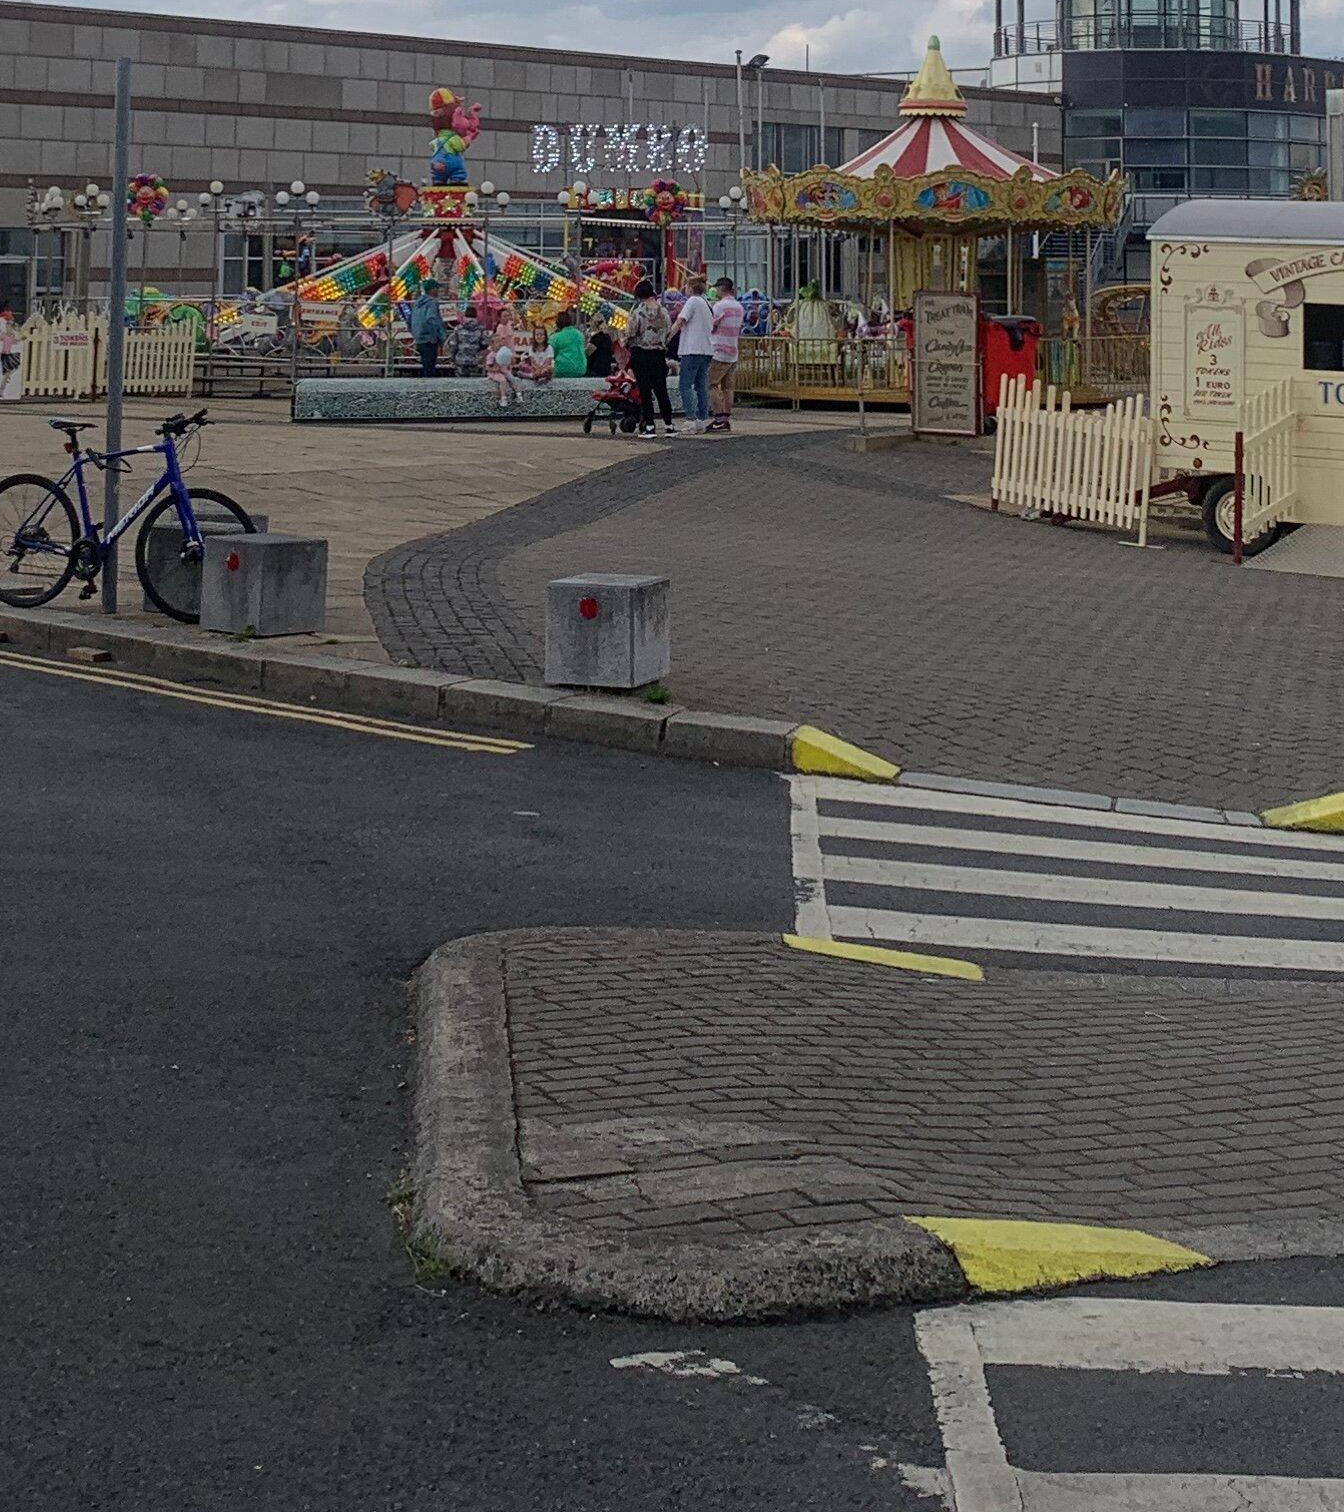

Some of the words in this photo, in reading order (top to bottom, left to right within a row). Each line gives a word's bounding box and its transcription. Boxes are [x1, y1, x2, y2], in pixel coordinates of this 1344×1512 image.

[531, 123, 709, 174] DUMBO
[1270, 254, 1326, 283] VINTAGE
[1197, 335, 1232, 355] Rides
[1209, 354, 1218, 365] 3
[1195, 367, 1231, 376] TOKENS
[1206, 381, 1231, 390] EURO
